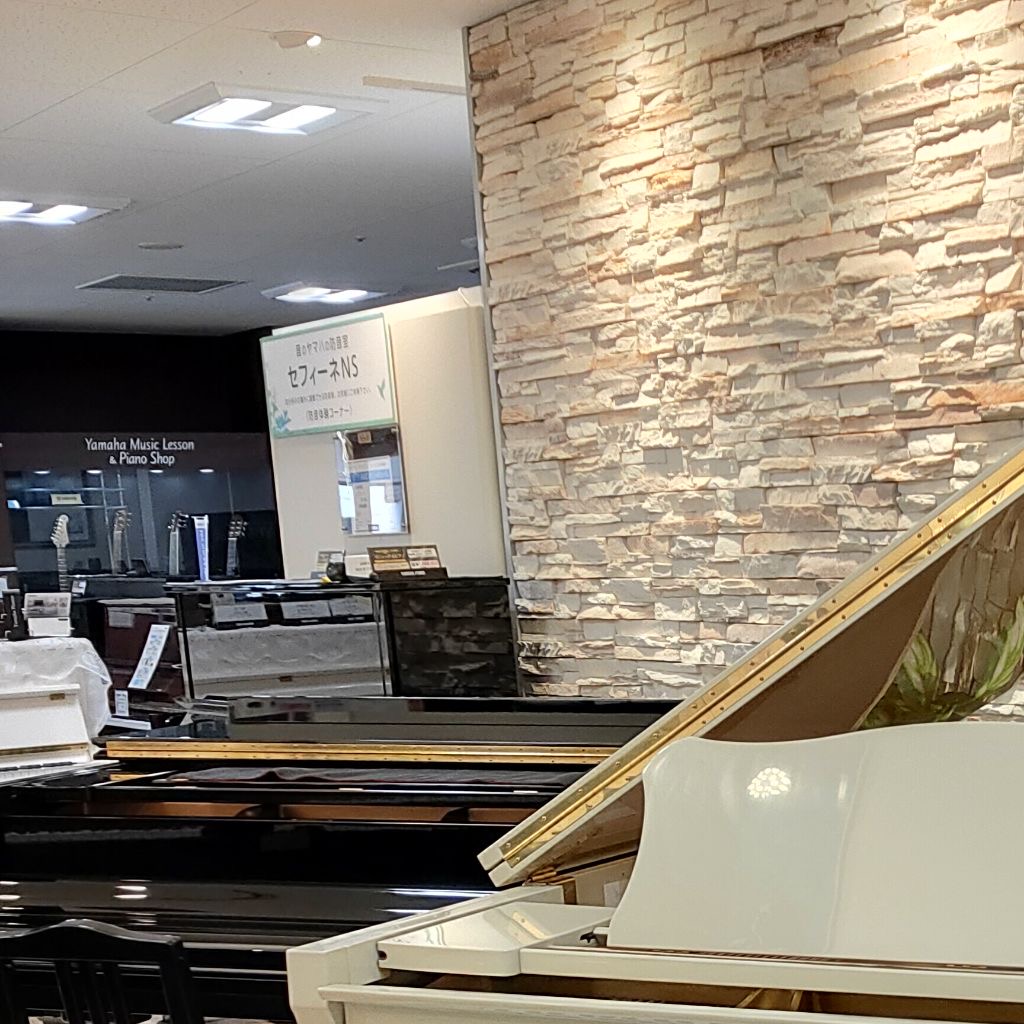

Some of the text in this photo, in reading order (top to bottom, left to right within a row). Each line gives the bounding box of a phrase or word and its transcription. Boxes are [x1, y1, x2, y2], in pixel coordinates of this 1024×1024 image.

[287, 354, 359, 388] セフィーネNS
[84, 437, 195, 451] Yamaha Music Lesson
[109, 451, 176, 467] & Piano Shop
